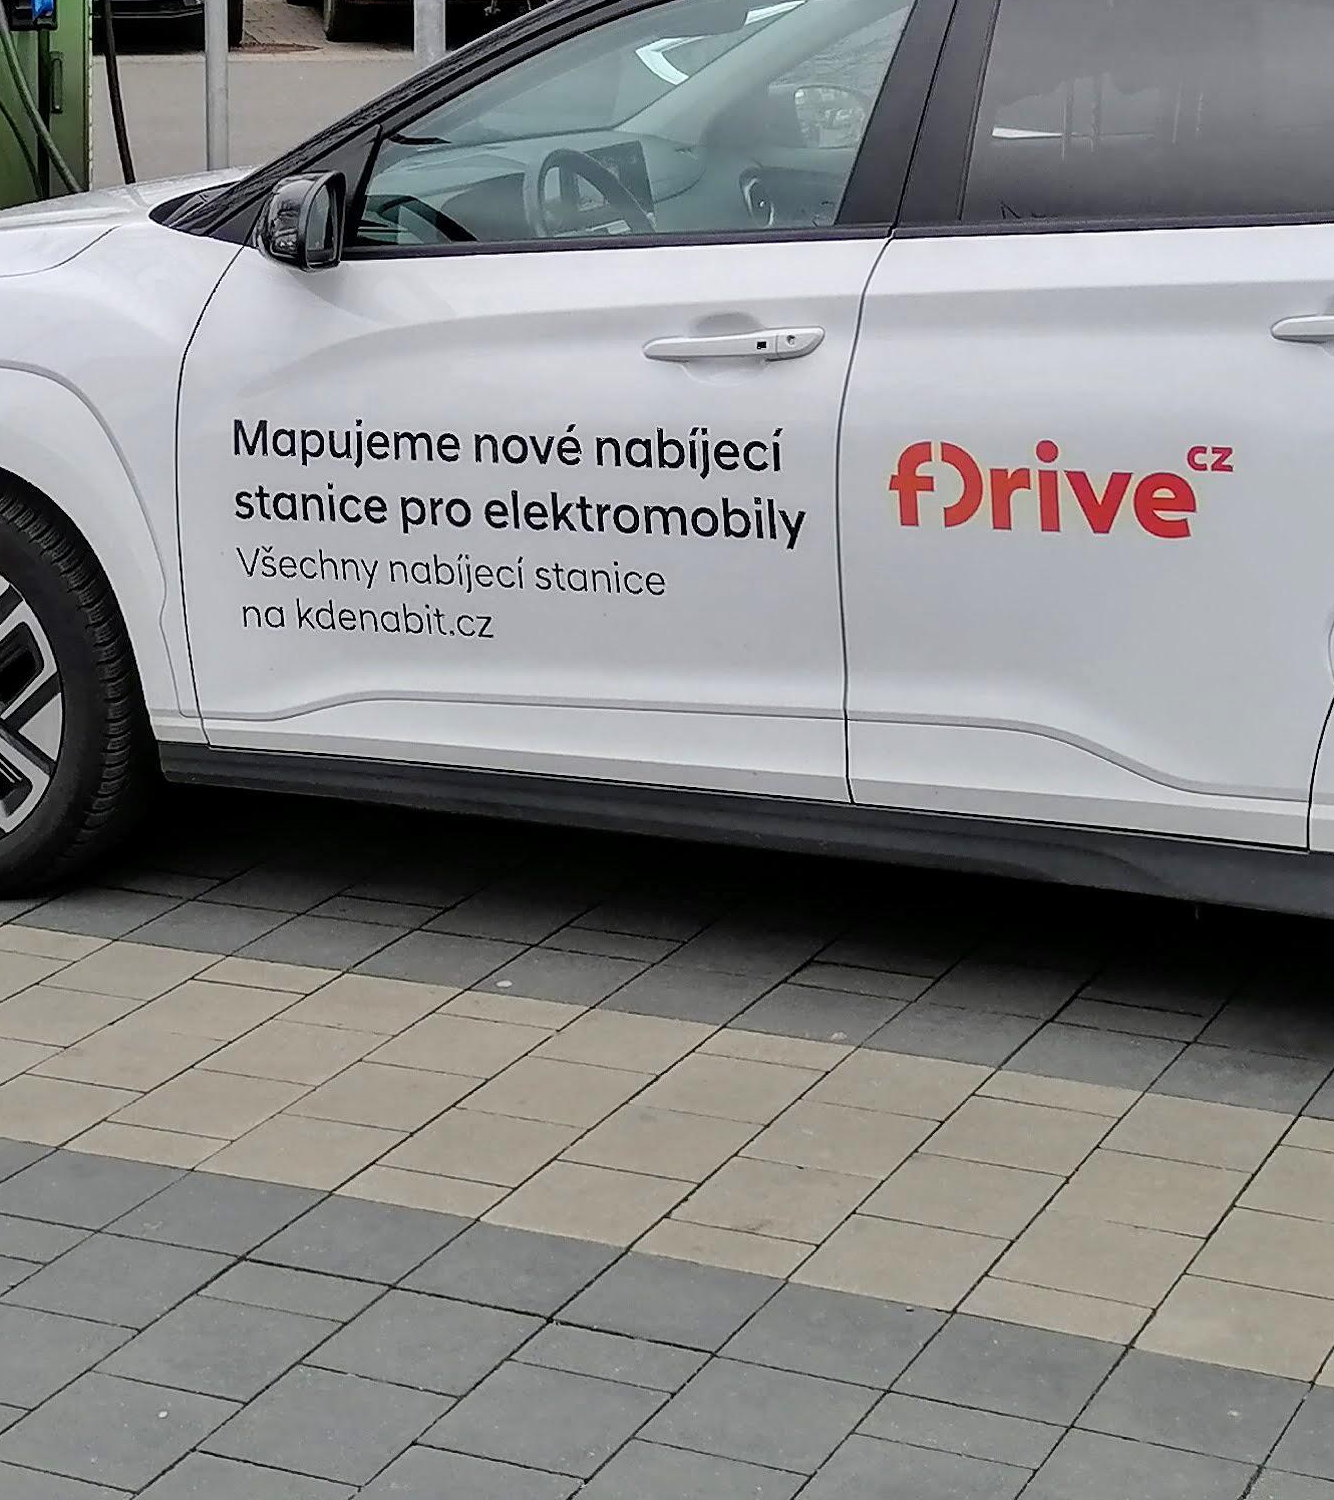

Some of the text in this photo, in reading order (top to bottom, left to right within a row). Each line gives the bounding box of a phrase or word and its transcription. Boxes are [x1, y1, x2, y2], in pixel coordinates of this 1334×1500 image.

[232, 418, 783, 480] Mapujeme nové nabíjecí
[234, 482, 806, 550] stanice pro elektromobily
[236, 545, 666, 596] Všechny nabíjecí stanice
[242, 598, 495, 639] na kdenabit.cz
